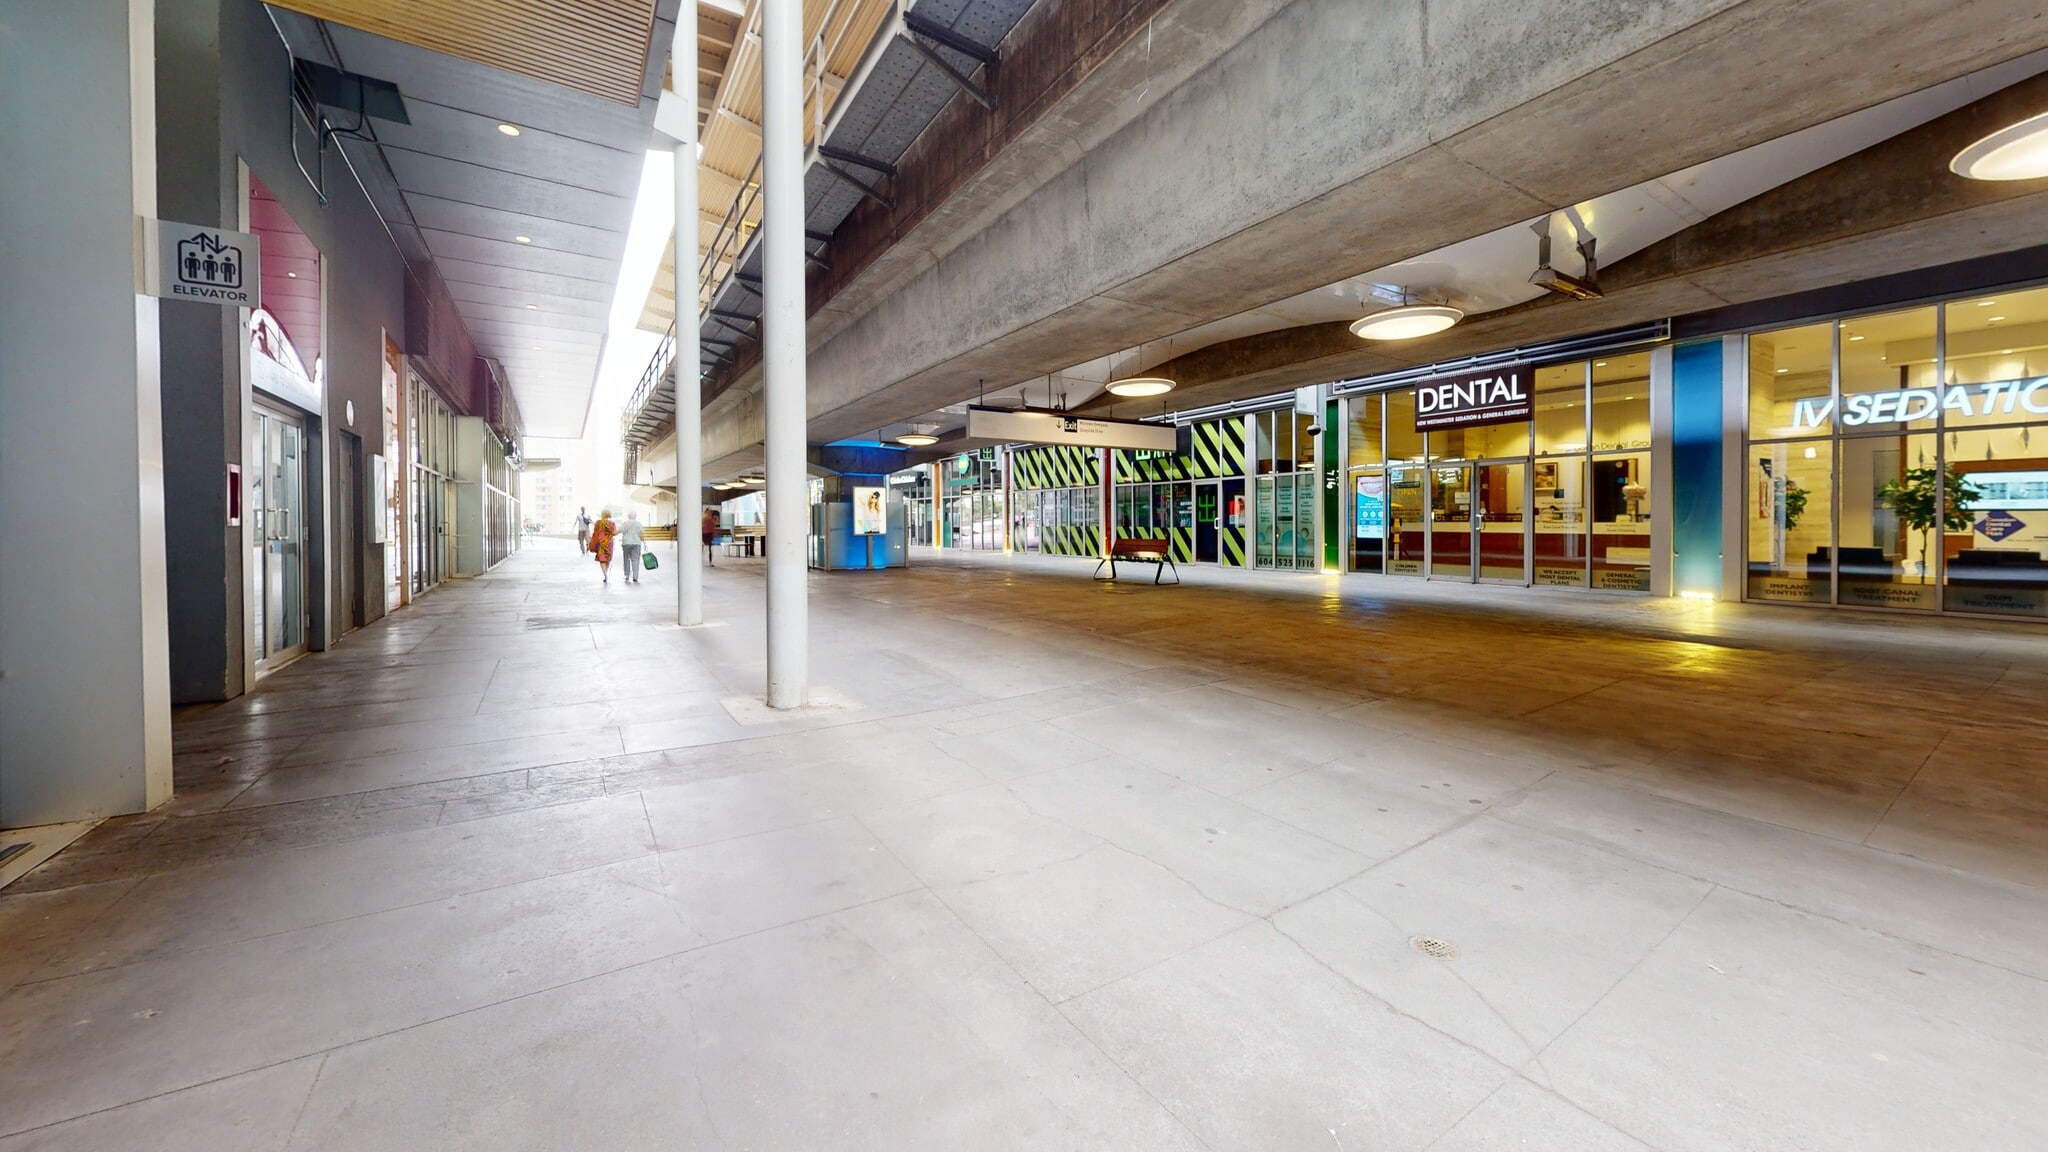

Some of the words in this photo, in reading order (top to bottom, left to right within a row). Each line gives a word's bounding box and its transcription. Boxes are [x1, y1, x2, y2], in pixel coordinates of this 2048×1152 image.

[173, 284, 248, 302] ELEVATOR
[1418, 374, 1527, 413] DENTAL
[1482, 410, 1504, 419] GENERAL
[1504, 407, 1529, 417] DENTISTRY
[1791, 399, 1835, 428] IV
[1065, 420, 1077, 430] Exit
[1397, 488, 1417, 496] OPEN
[1258, 558, 1273, 566] 604
[1278, 559, 1293, 567] 525
[1297, 560, 1315, 568] 1116
[1765, 589, 1814, 597] DENTISTRY
[1853, 587, 1881, 596] ROOT
[1883, 588, 1921, 597] CANAL
[1856, 594, 1919, 603] TREATMENT
[1984, 593, 2013, 601] GUM
[1963, 599, 2036, 609] TREATMENT
